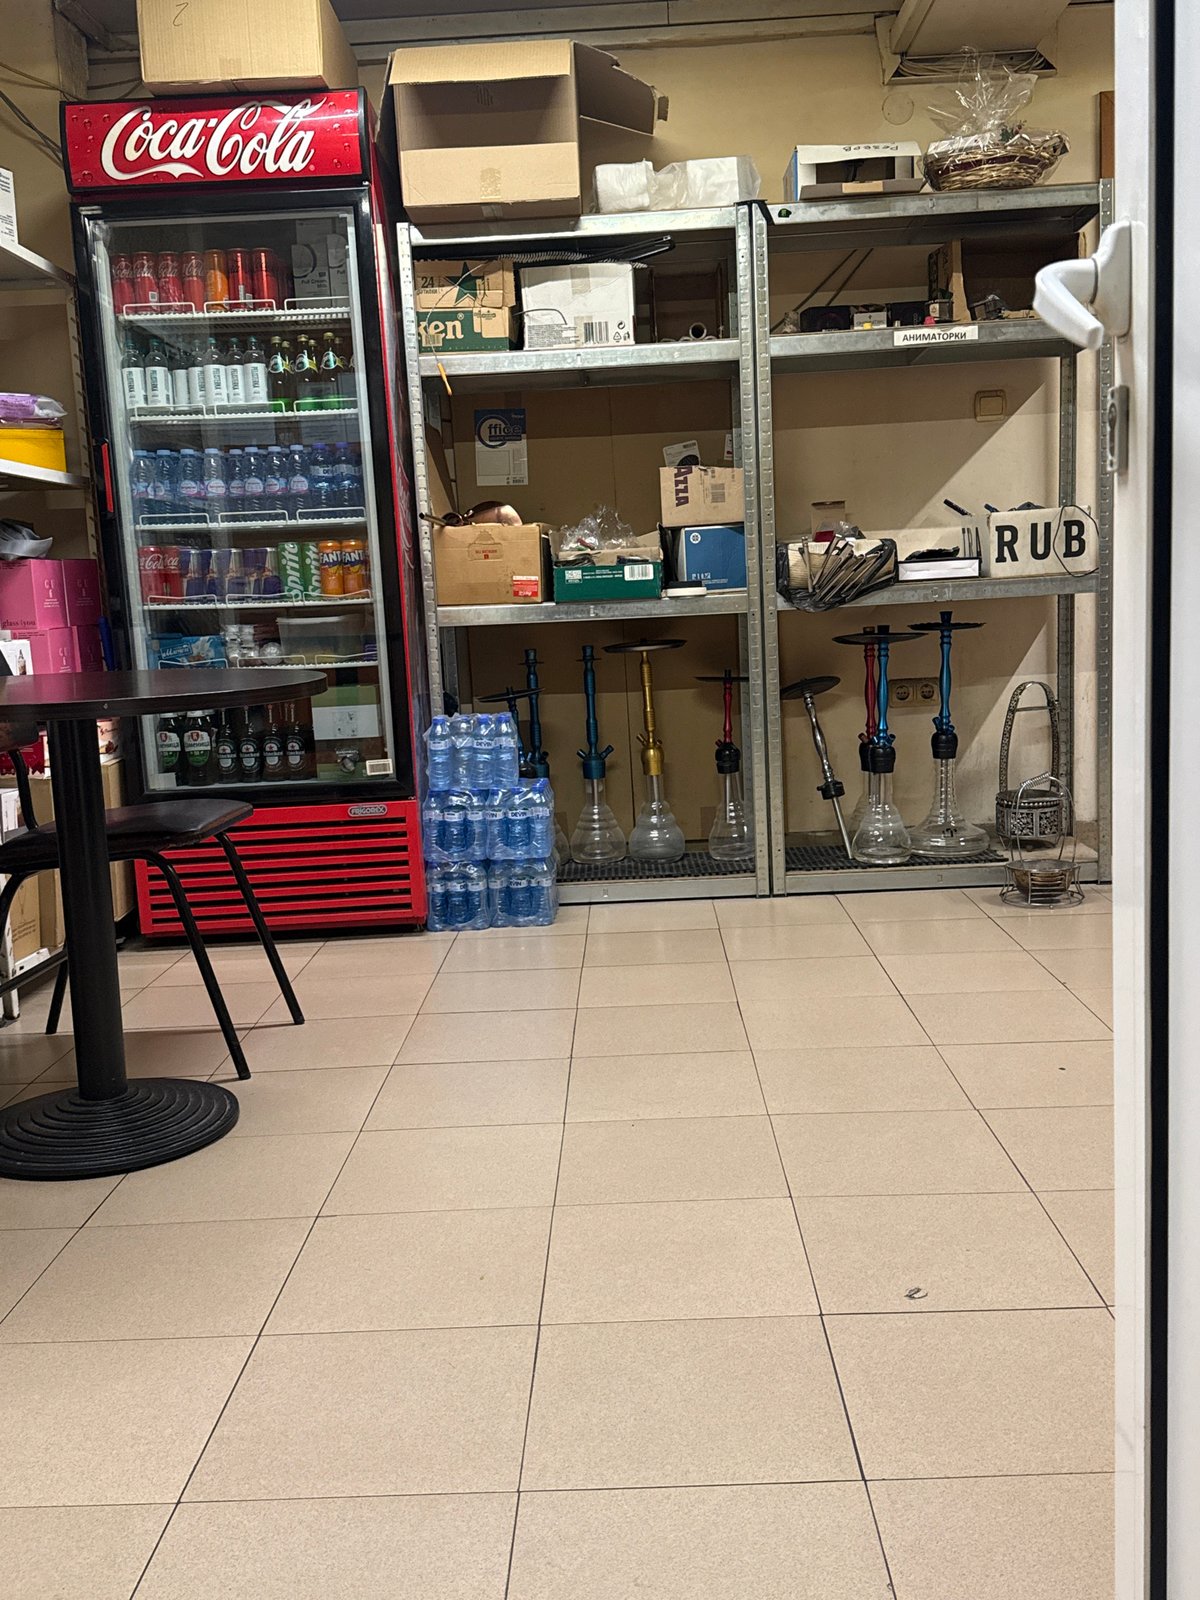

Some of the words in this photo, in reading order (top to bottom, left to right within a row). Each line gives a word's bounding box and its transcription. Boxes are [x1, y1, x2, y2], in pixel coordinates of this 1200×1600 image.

[101, 96, 327, 181] Coca-Cola
[421, 276, 434, 288] 24
[902, 331, 967, 342] АНИМАТОРКИ
[674, 467, 693, 507] AZZA
[320, 550, 341, 563] FANT
[342, 549, 364, 562] FANT
